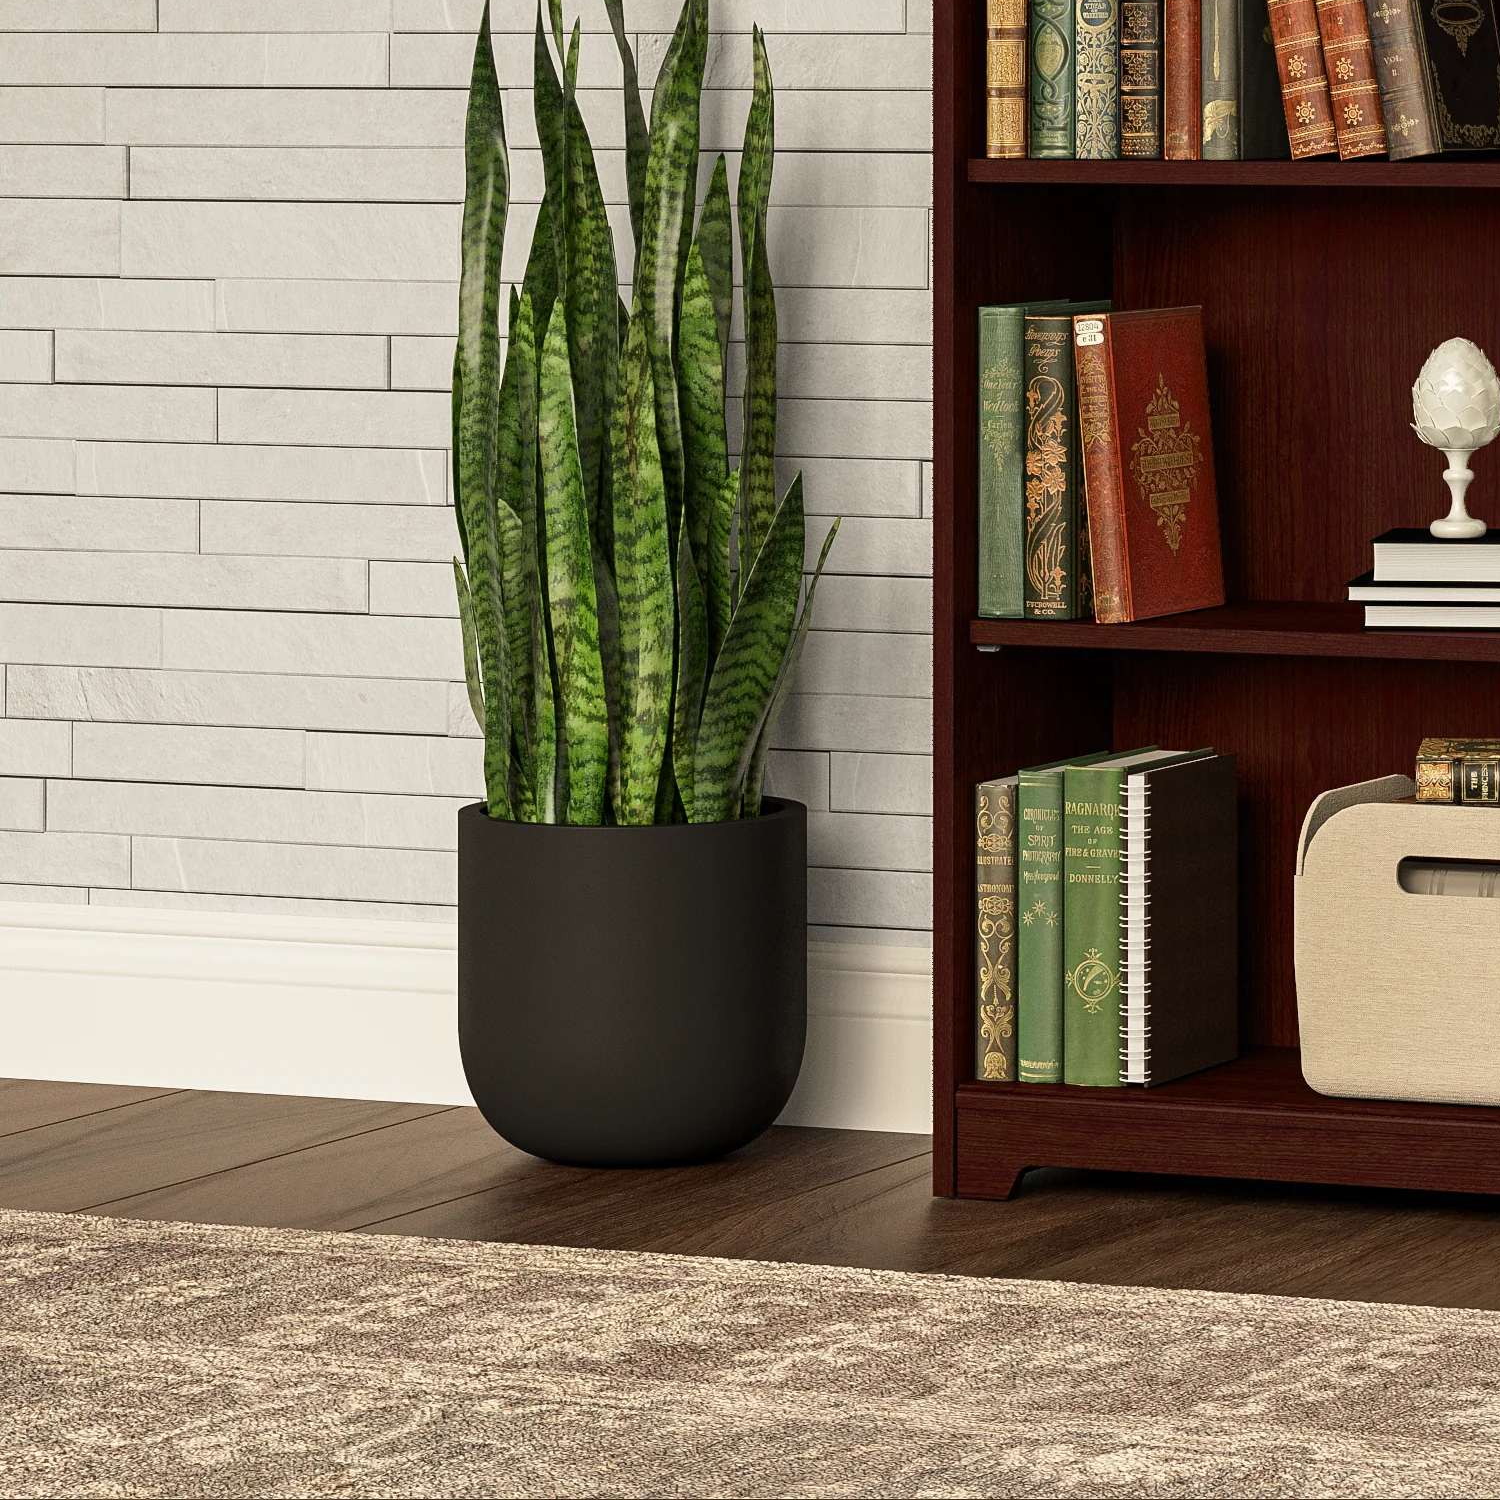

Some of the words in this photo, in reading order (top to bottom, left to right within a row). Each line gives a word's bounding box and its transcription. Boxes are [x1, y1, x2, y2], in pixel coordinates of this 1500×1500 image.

[1287, 17, 1292, 25] 1
[1337, 16, 1343, 25] 2
[1077, 322, 1100, 332] 12804
[1088, 334, 1097, 342] 31
[1028, 343, 1061, 357] Poems
[1470, 770, 1479, 790] THE
[1071, 825, 1090, 834] THE
[1094, 826, 1113, 834] AGE
[1028, 834, 1056, 848] SPIRIT
[1069, 873, 1118, 883] DONNELLY
